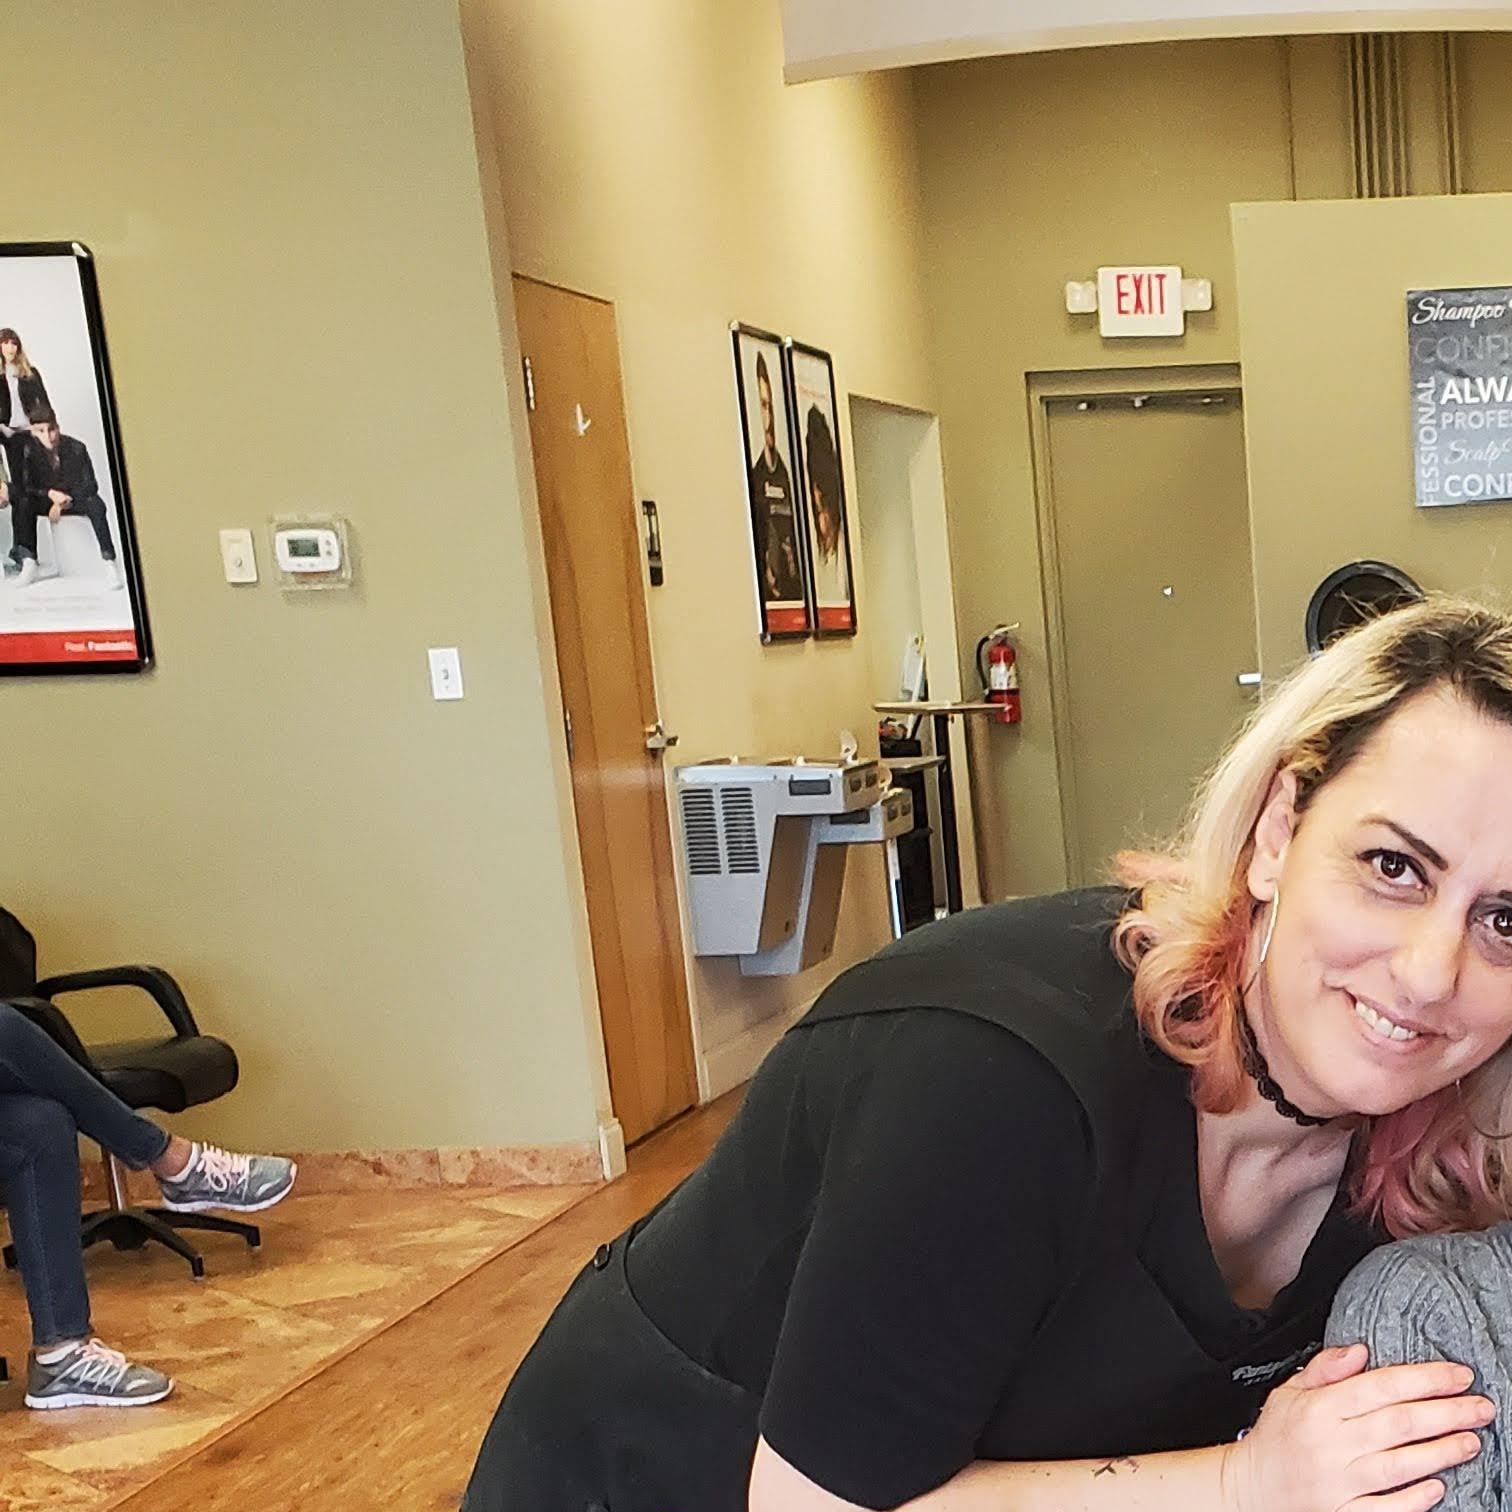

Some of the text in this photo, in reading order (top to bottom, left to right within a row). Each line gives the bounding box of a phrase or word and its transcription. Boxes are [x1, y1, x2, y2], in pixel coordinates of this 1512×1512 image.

[1116, 273, 1167, 314] EXIT
[1412, 296, 1506, 328] Shampoo
[1444, 439, 1501, 469] Scalp
